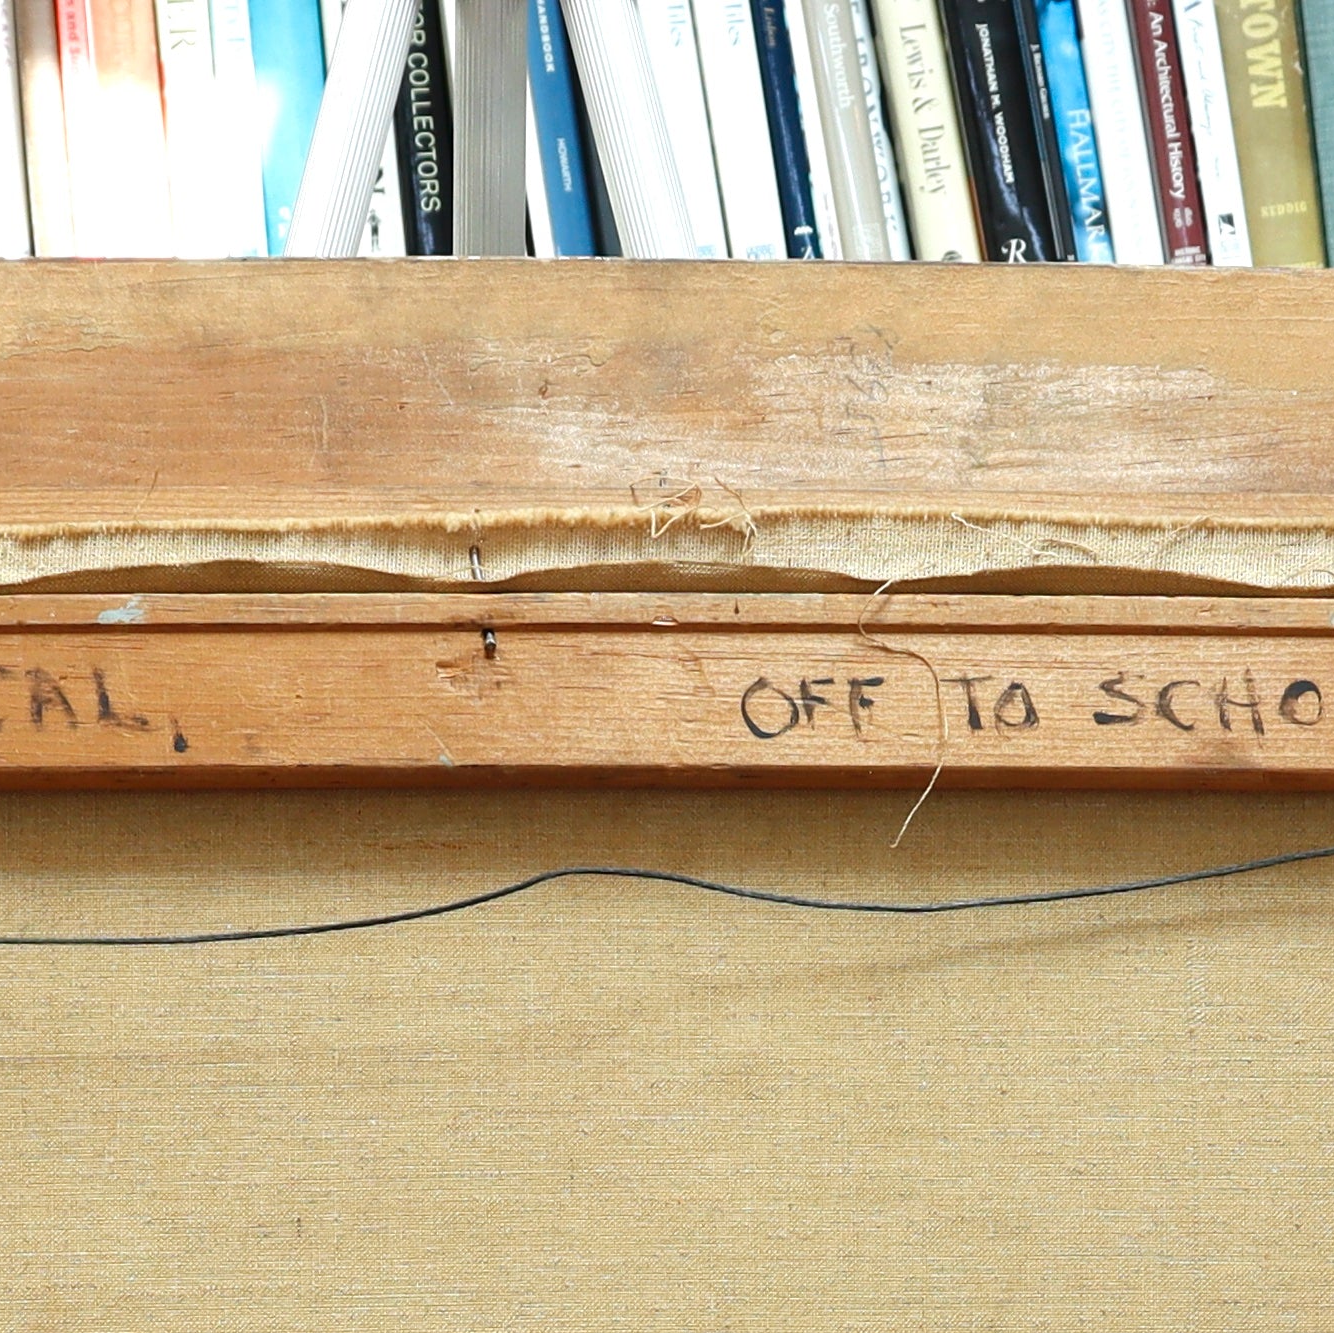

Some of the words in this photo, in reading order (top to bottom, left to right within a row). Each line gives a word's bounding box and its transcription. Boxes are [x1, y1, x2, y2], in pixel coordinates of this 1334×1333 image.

[825, 3, 853, 109] Southworth
[899, 23, 933, 95] Lewis
[1148, 11, 1165, 36] An
[912, 97, 938, 114] &
[975, 23, 1000, 93] JONATHAN
[994, 111, 1015, 184] WOODHAM
[1152, 39, 1181, 141] Architectural
[407, 52, 442, 213] COLLECTORS
[918, 124, 952, 195] Darley
[1168, 142, 1186, 200] History
[740, 674, 886, 741] OFF
[940, 673, 1040, 735] TO
